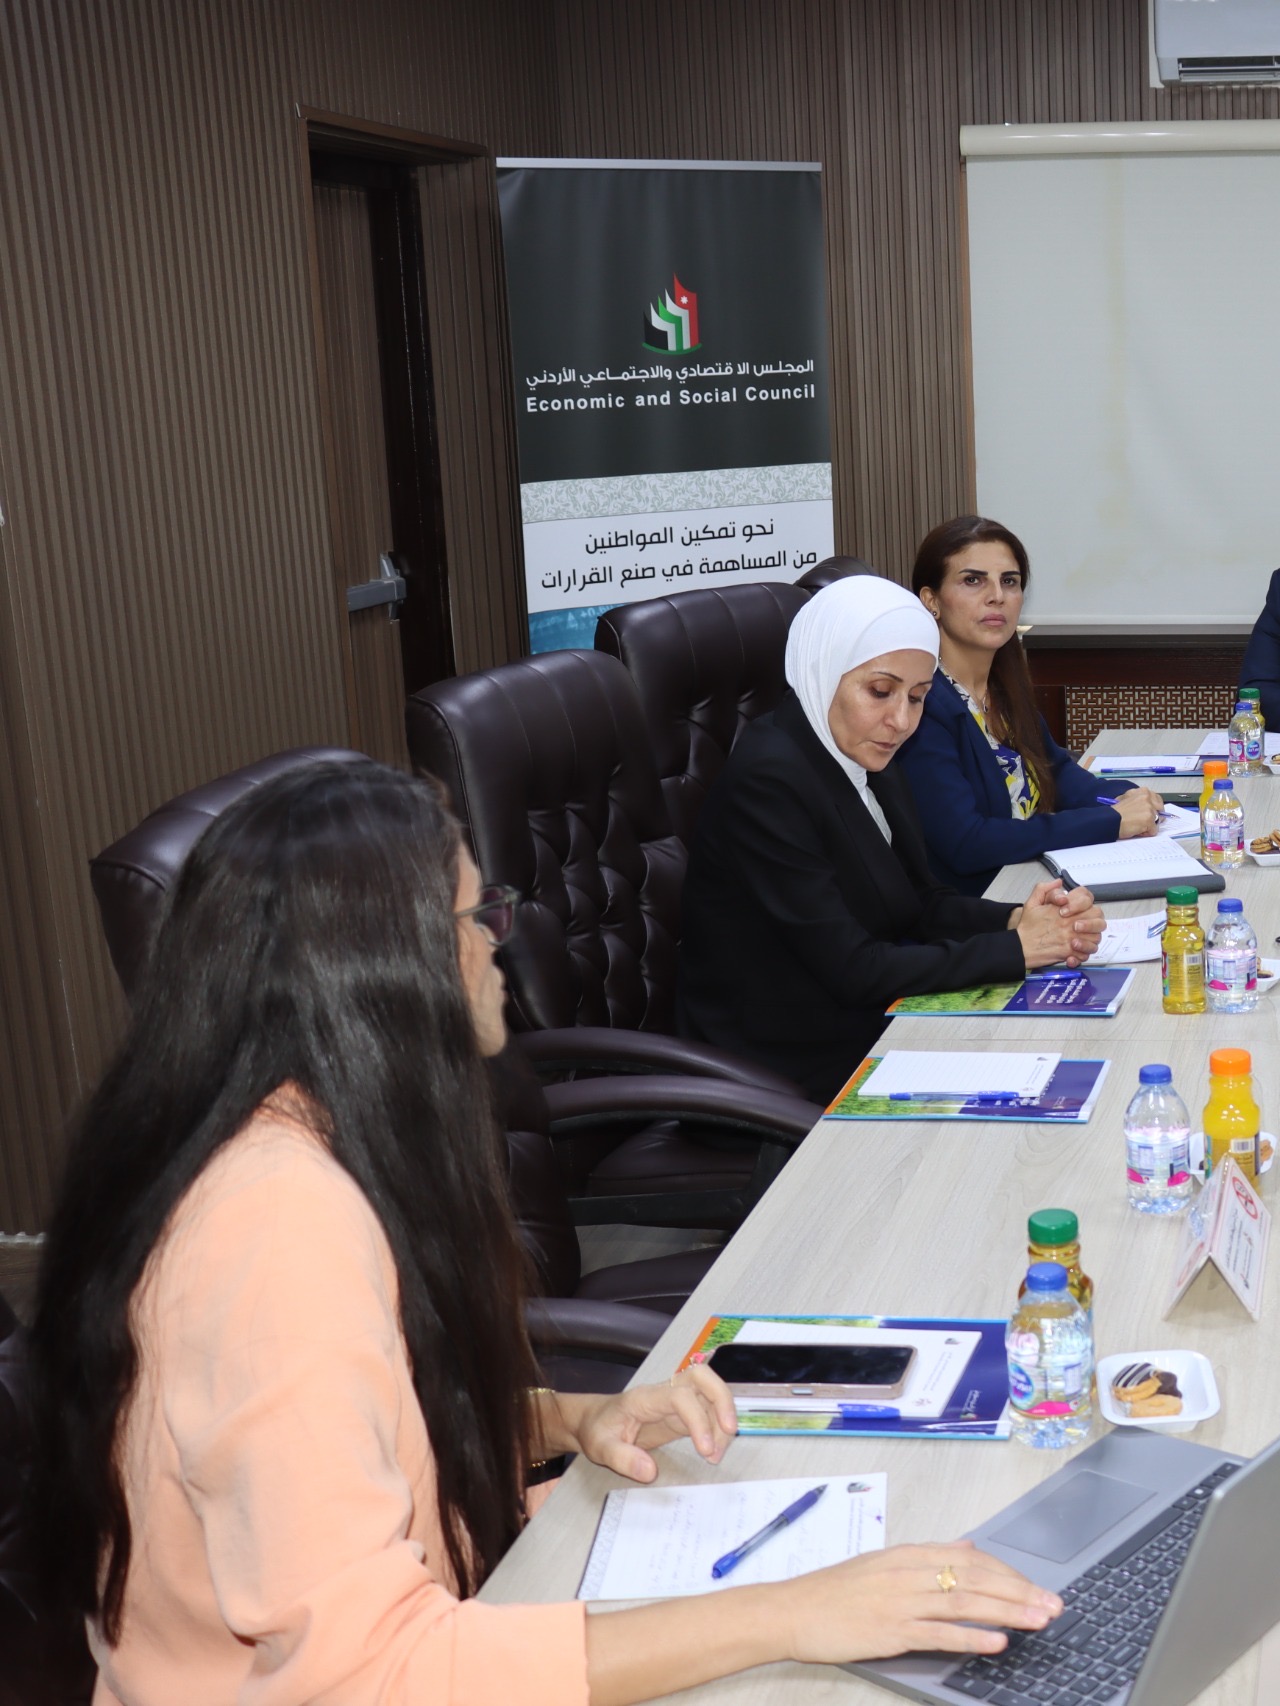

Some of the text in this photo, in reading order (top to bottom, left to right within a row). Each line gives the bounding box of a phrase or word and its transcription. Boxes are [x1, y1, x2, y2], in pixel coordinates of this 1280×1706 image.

[525, 366, 576, 391] الأردني
[579, 365, 673, 389] والاجتماعي
[753, 359, 814, 377] المجلس
[526, 383, 815, 413] Economic and Social Council
[585, 518, 775, 555] نحو تمكين المواطنين
[541, 550, 817, 593] من المساهمة في صنع القرارات
